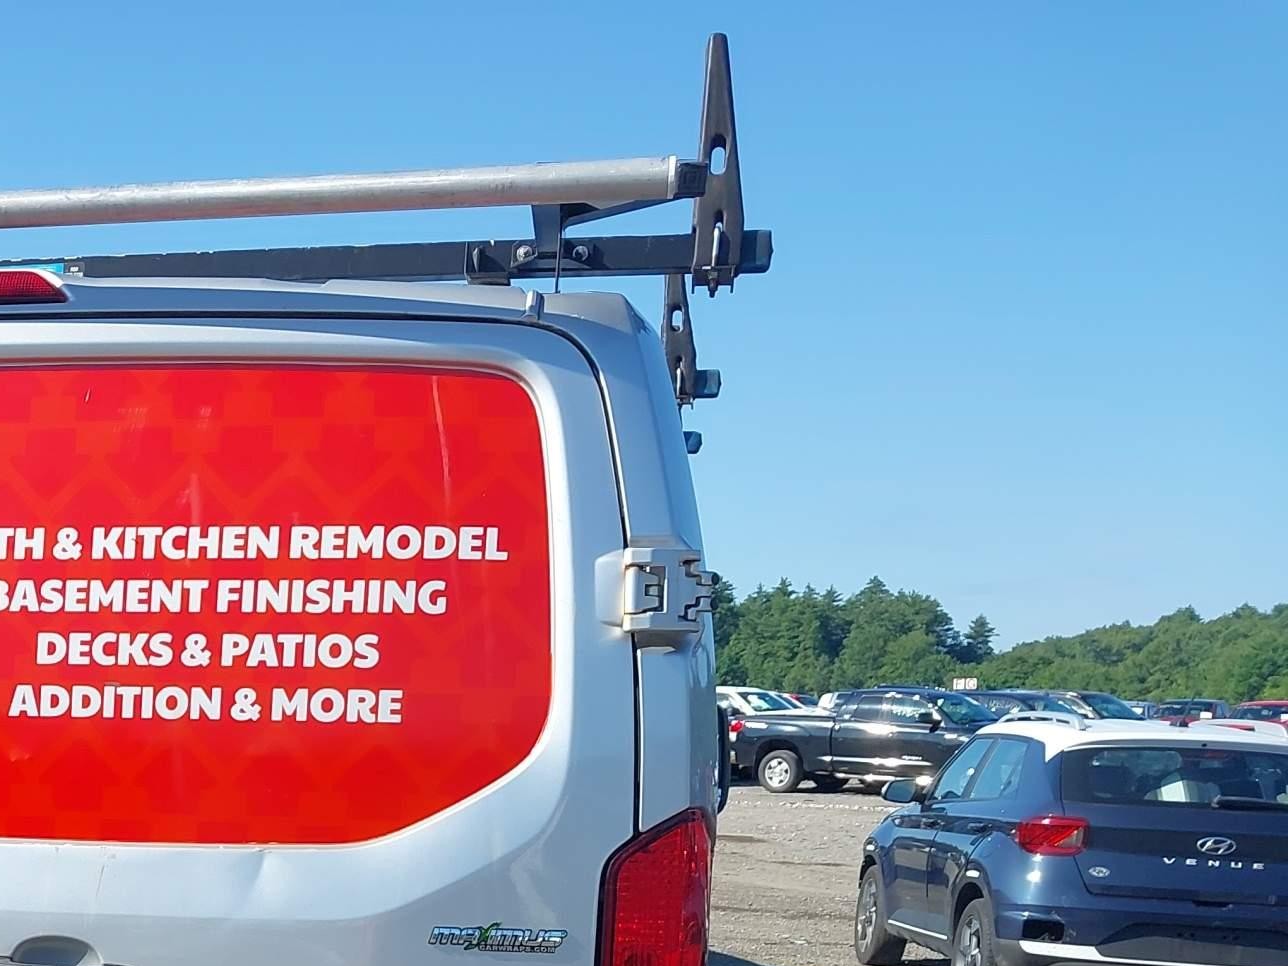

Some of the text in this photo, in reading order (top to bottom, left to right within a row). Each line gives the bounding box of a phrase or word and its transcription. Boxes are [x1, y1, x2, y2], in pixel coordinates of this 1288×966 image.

[53, 527, 83, 561] &
[92, 526, 280, 560] KITCHEN
[290, 525, 509, 561] REMODEL
[217, 579, 447, 615] FINISHING
[36, 632, 380, 669] DECKS & PATIOS
[9, 684, 403, 724] ADDITION & MORE
[1163, 857, 1265, 870] VENUE
[479, 944, 556, 953] CARWRAPS.COM
